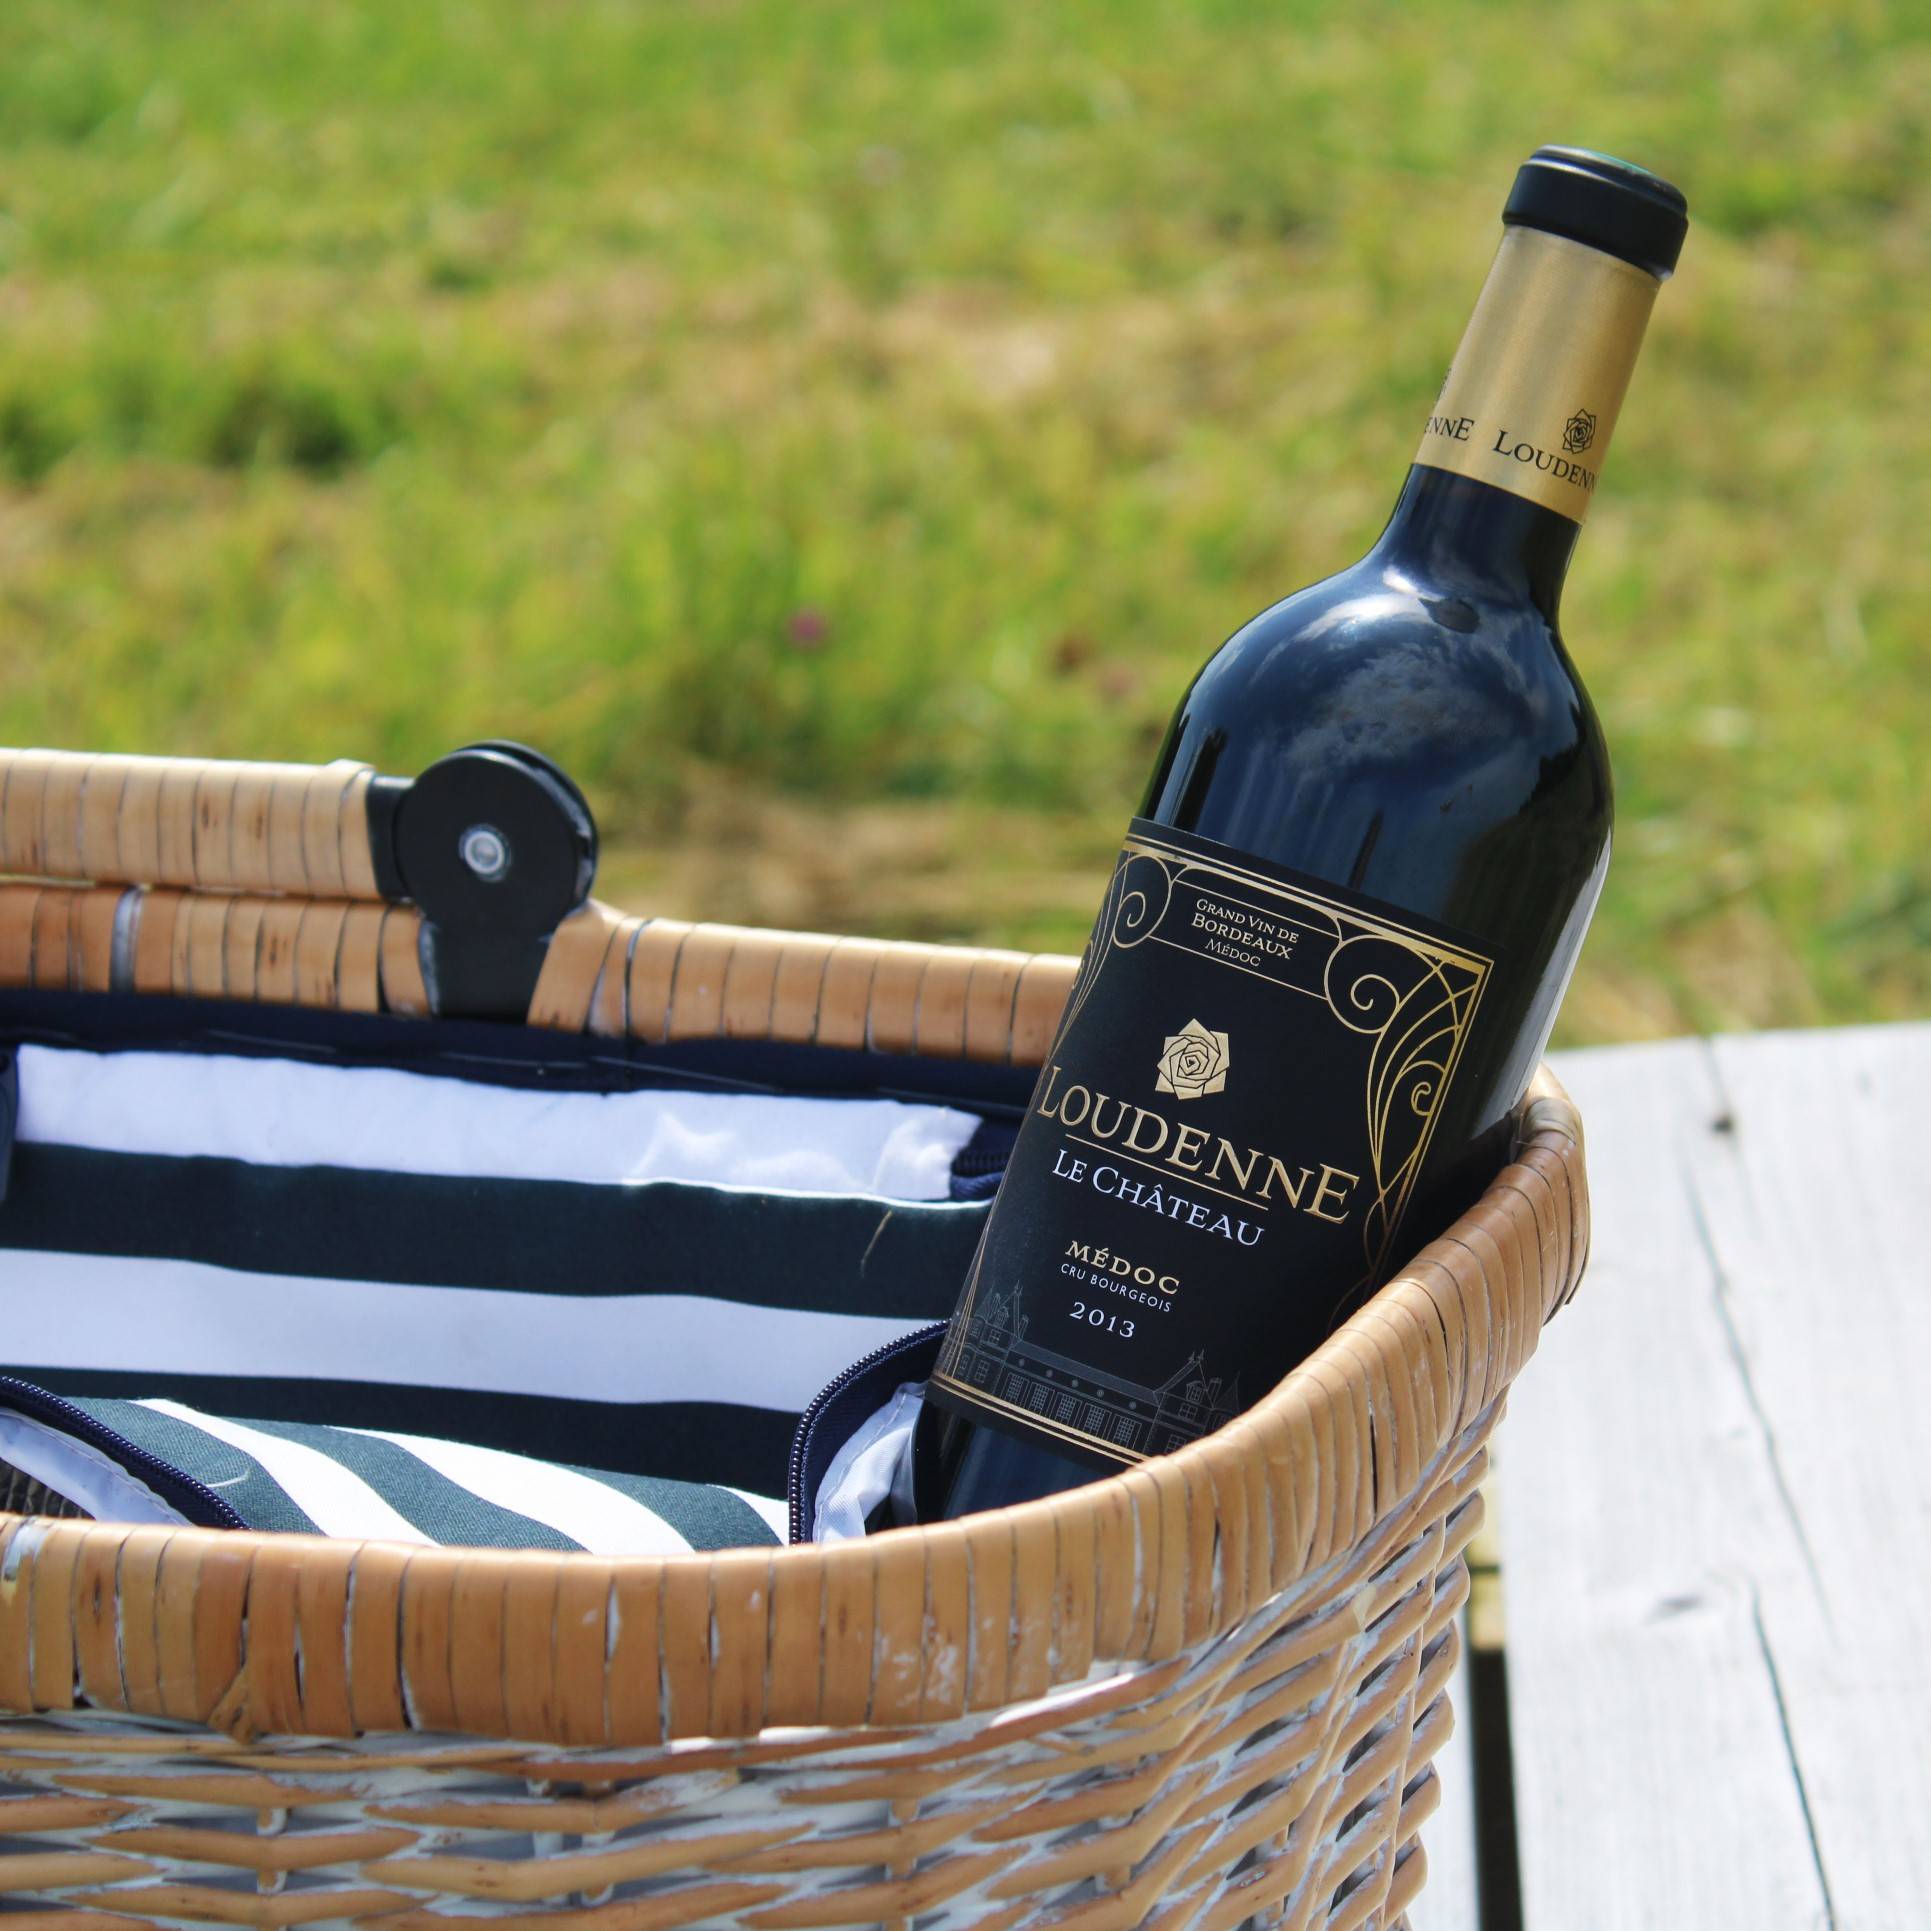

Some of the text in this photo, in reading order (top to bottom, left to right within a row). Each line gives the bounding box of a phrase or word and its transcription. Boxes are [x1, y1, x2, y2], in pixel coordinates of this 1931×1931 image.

[1191, 912, 1293, 960] BORDEAUX
[1196, 898, 1300, 944] GRAND VIN DE
[1204, 938, 1261, 967] MÉDOC
[1036, 1065, 1360, 1225] LOUDENNE
[1052, 1149, 1265, 1246] LE CHÂTEAU
[1061, 1263, 1172, 1312] CRU BOURGEOIS
[1064, 1240, 1180, 1295] MÉDOC
[1069, 1301, 1135, 1338] 2013
